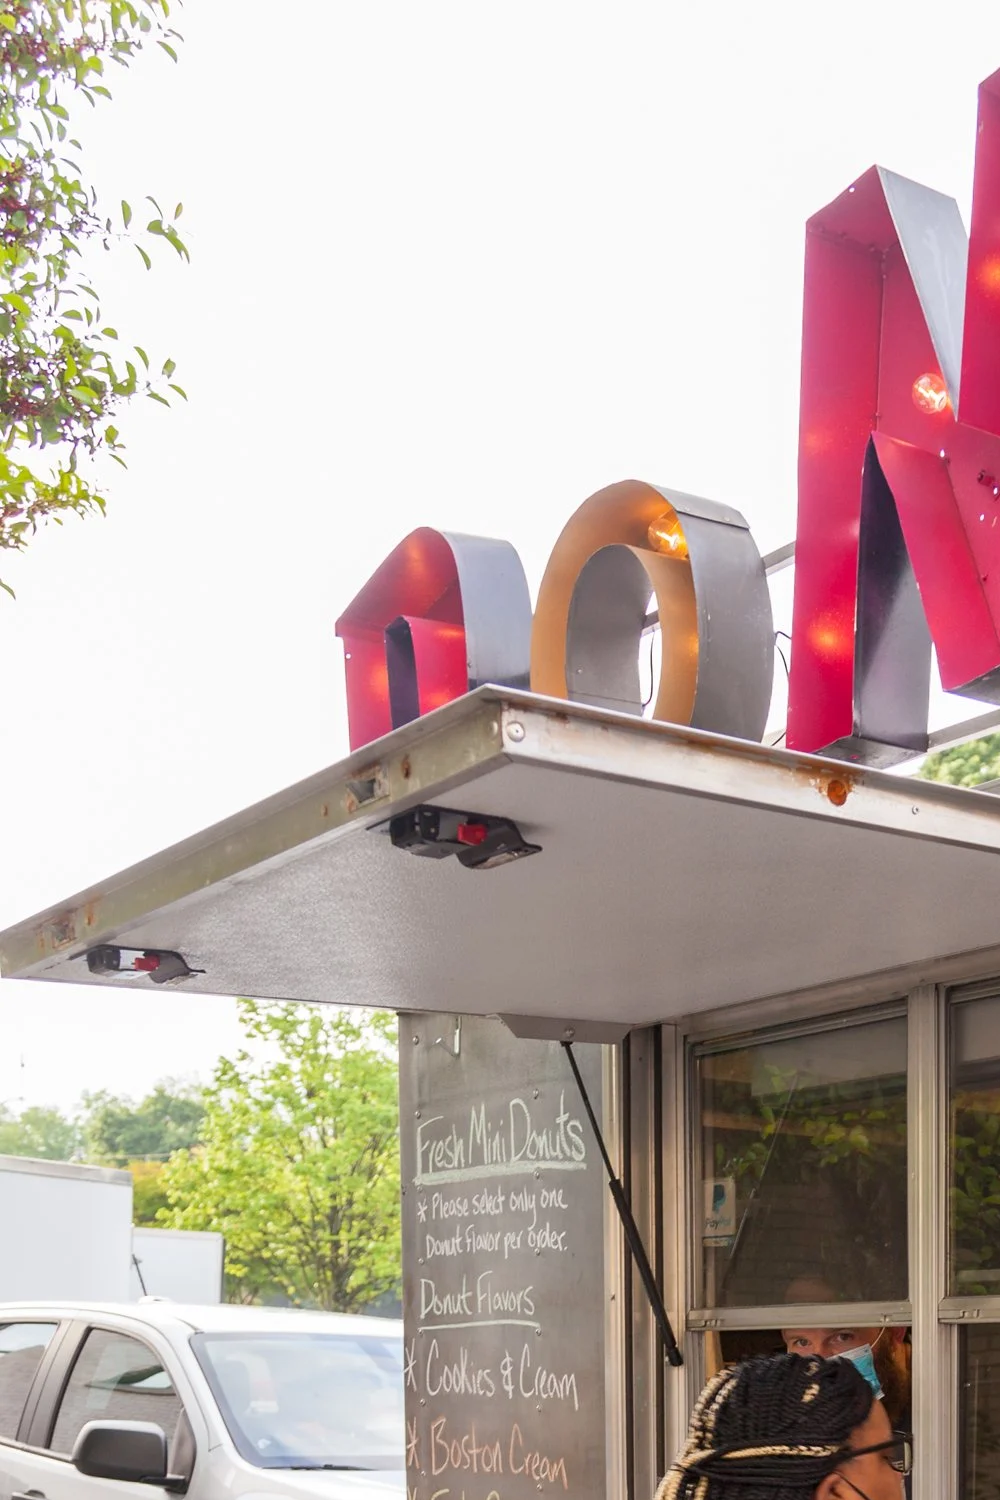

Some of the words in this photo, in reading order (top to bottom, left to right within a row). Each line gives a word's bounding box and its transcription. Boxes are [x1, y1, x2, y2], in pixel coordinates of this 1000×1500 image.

[416, 1115, 466, 1174] Fresh
[469, 1103, 506, 1165] Mini
[509, 1089, 586, 1162] Donuts
[432, 1191, 470, 1220] Please
[472, 1186, 505, 1216] select
[509, 1189, 537, 1231] only
[540, 1188, 568, 1211] one
[426, 1231, 463, 1260] Donut
[464, 1224, 501, 1253] flavor
[504, 1231, 523, 1259] per
[527, 1222, 568, 1252] order.
[420, 1274, 473, 1319] Donut
[476, 1270, 535, 1316] Flavors
[426, 1339, 495, 1397] Cookies
[519, 1344, 579, 1411] Cream
[431, 1416, 502, 1476] Boston
[509, 1423, 568, 1490] Cream
